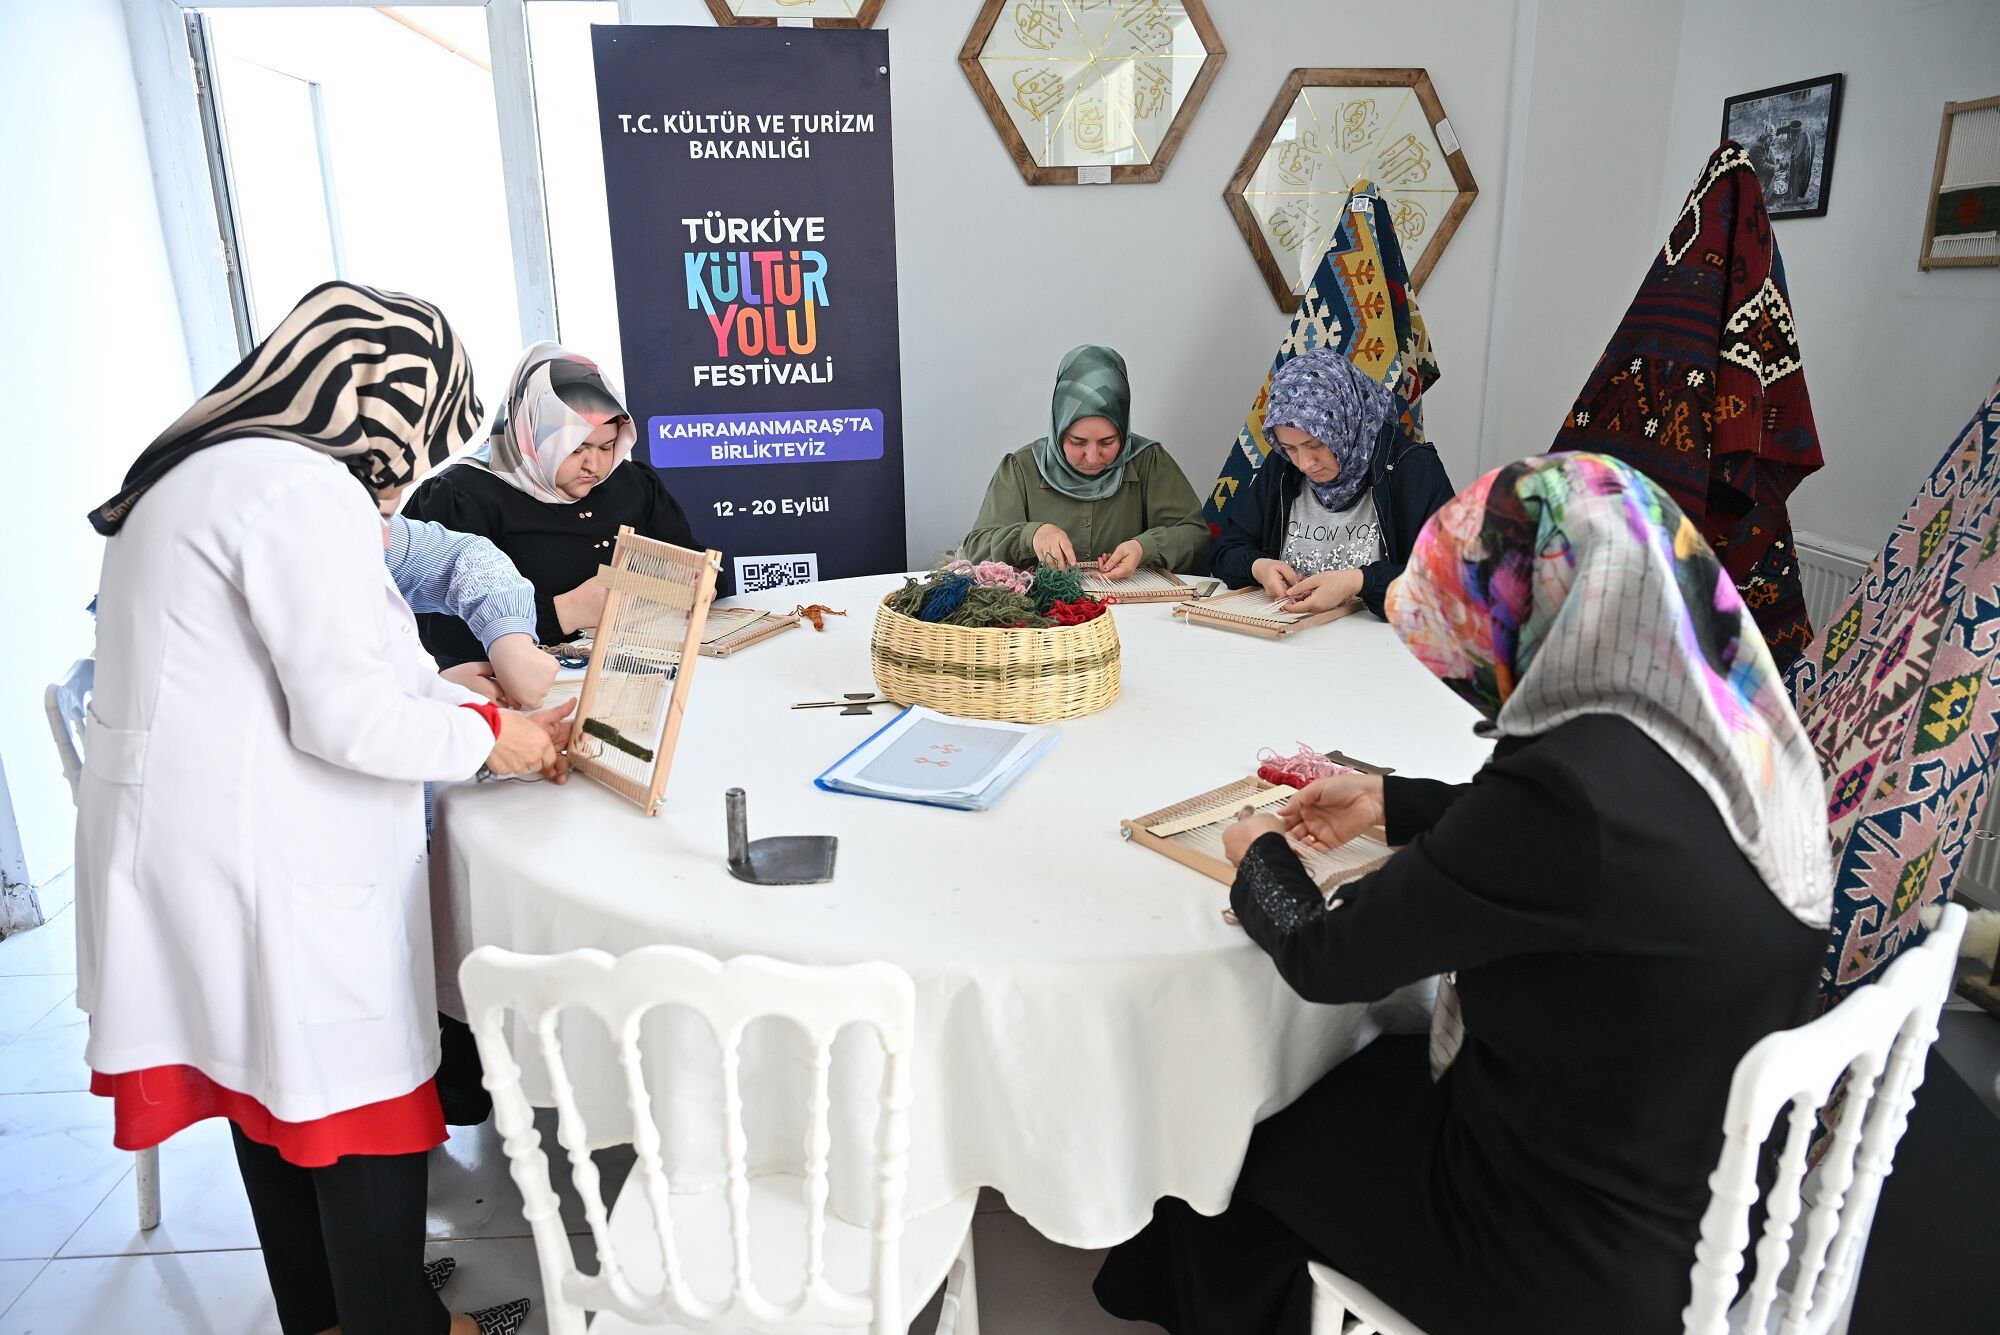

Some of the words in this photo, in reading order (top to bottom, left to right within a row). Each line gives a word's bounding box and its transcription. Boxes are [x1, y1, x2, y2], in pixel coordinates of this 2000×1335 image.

[617, 114, 658, 134] T.C.
[663, 110, 751, 134] KÜLTÜR
[755, 114, 785, 134] VE
[789, 110, 874, 134] TURİZM
[689, 136, 810, 159] BAKANLIĞI
[682, 209, 825, 244] TÜRKİYE
[684, 251, 829, 310] KÜLTÜR
[704, 299, 817, 357] YOLU
[694, 356, 832, 387] FESTİVALİ
[659, 417, 874, 439] KAHRAMANMARAŞ'TA
[710, 438, 825, 459] BİRLİKTEYİZ
[713, 501, 734, 517] 12
[751, 499, 777, 515] 20
[781, 496, 830, 517] Eylül
[1287, 521, 1339, 541] OLLOW
[1345, 524, 1375, 540] YO
